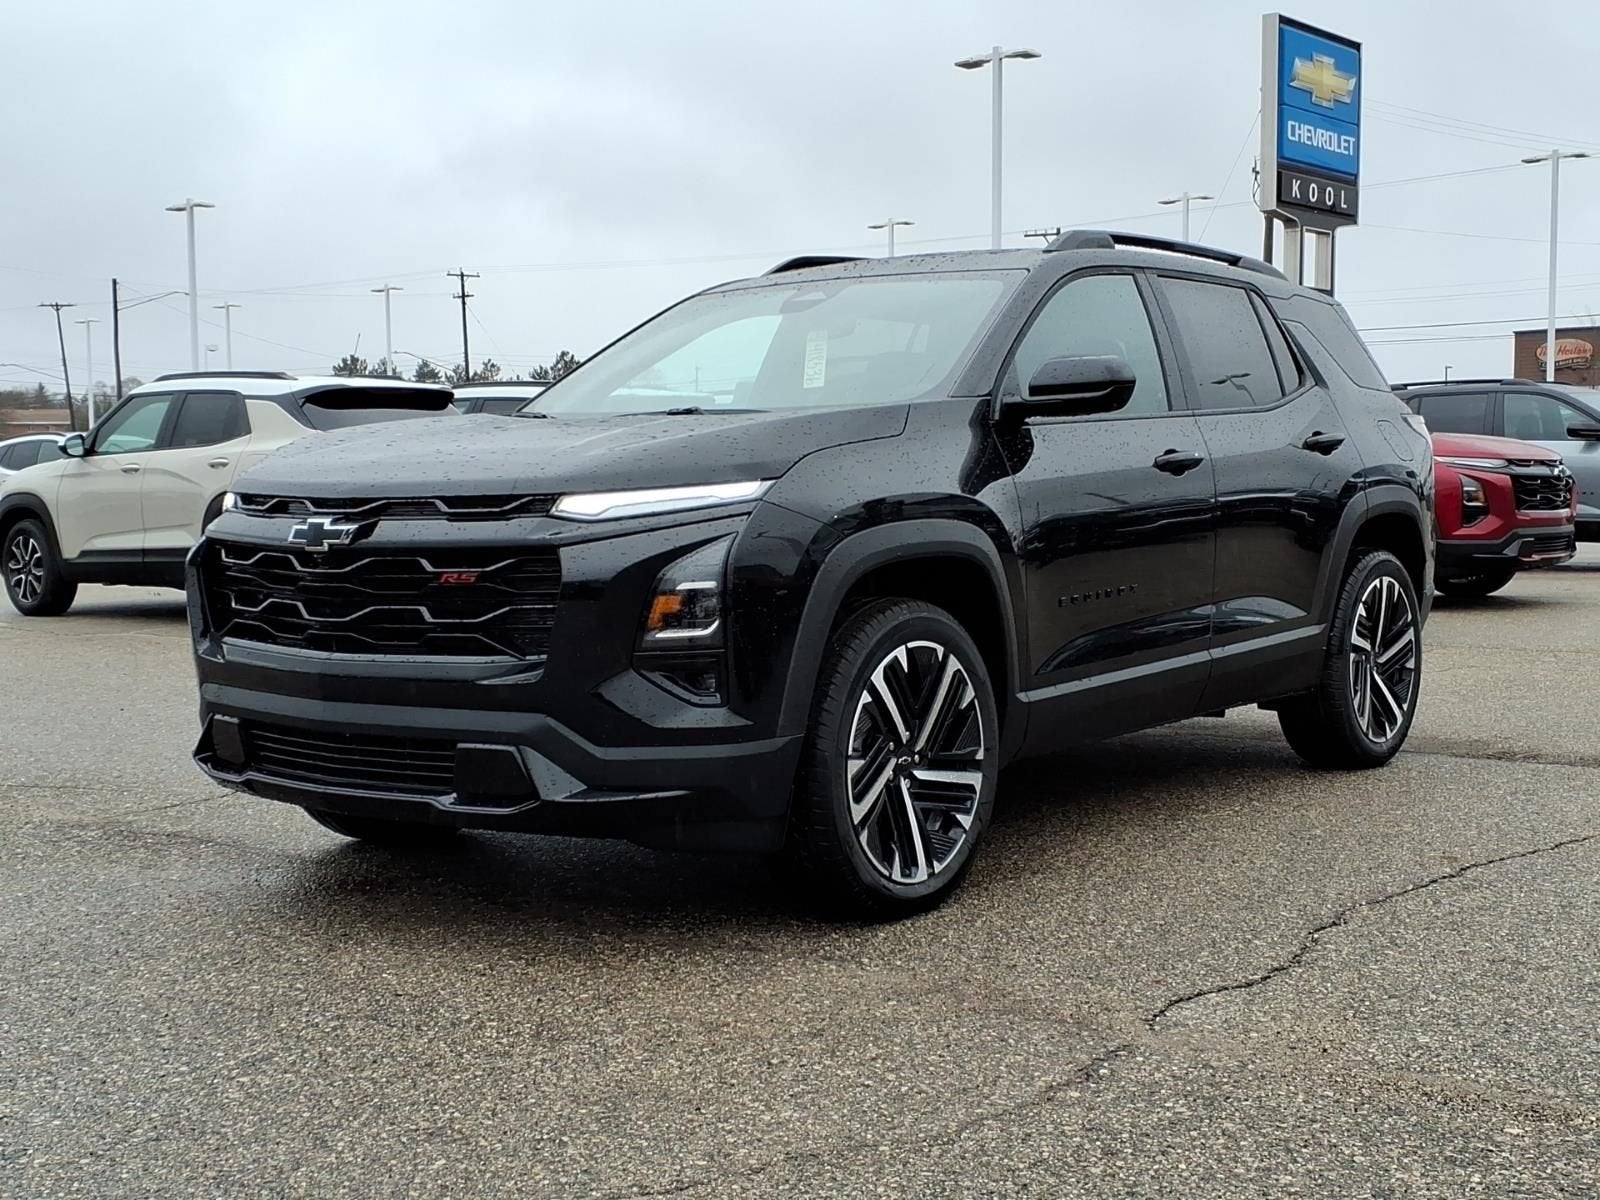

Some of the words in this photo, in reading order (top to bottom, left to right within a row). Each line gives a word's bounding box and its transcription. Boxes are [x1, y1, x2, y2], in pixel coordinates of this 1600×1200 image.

[1287, 120, 1356, 156] CHEVROLET
[1291, 178, 1348, 209] KOOL
[439, 571, 480, 583] RS
